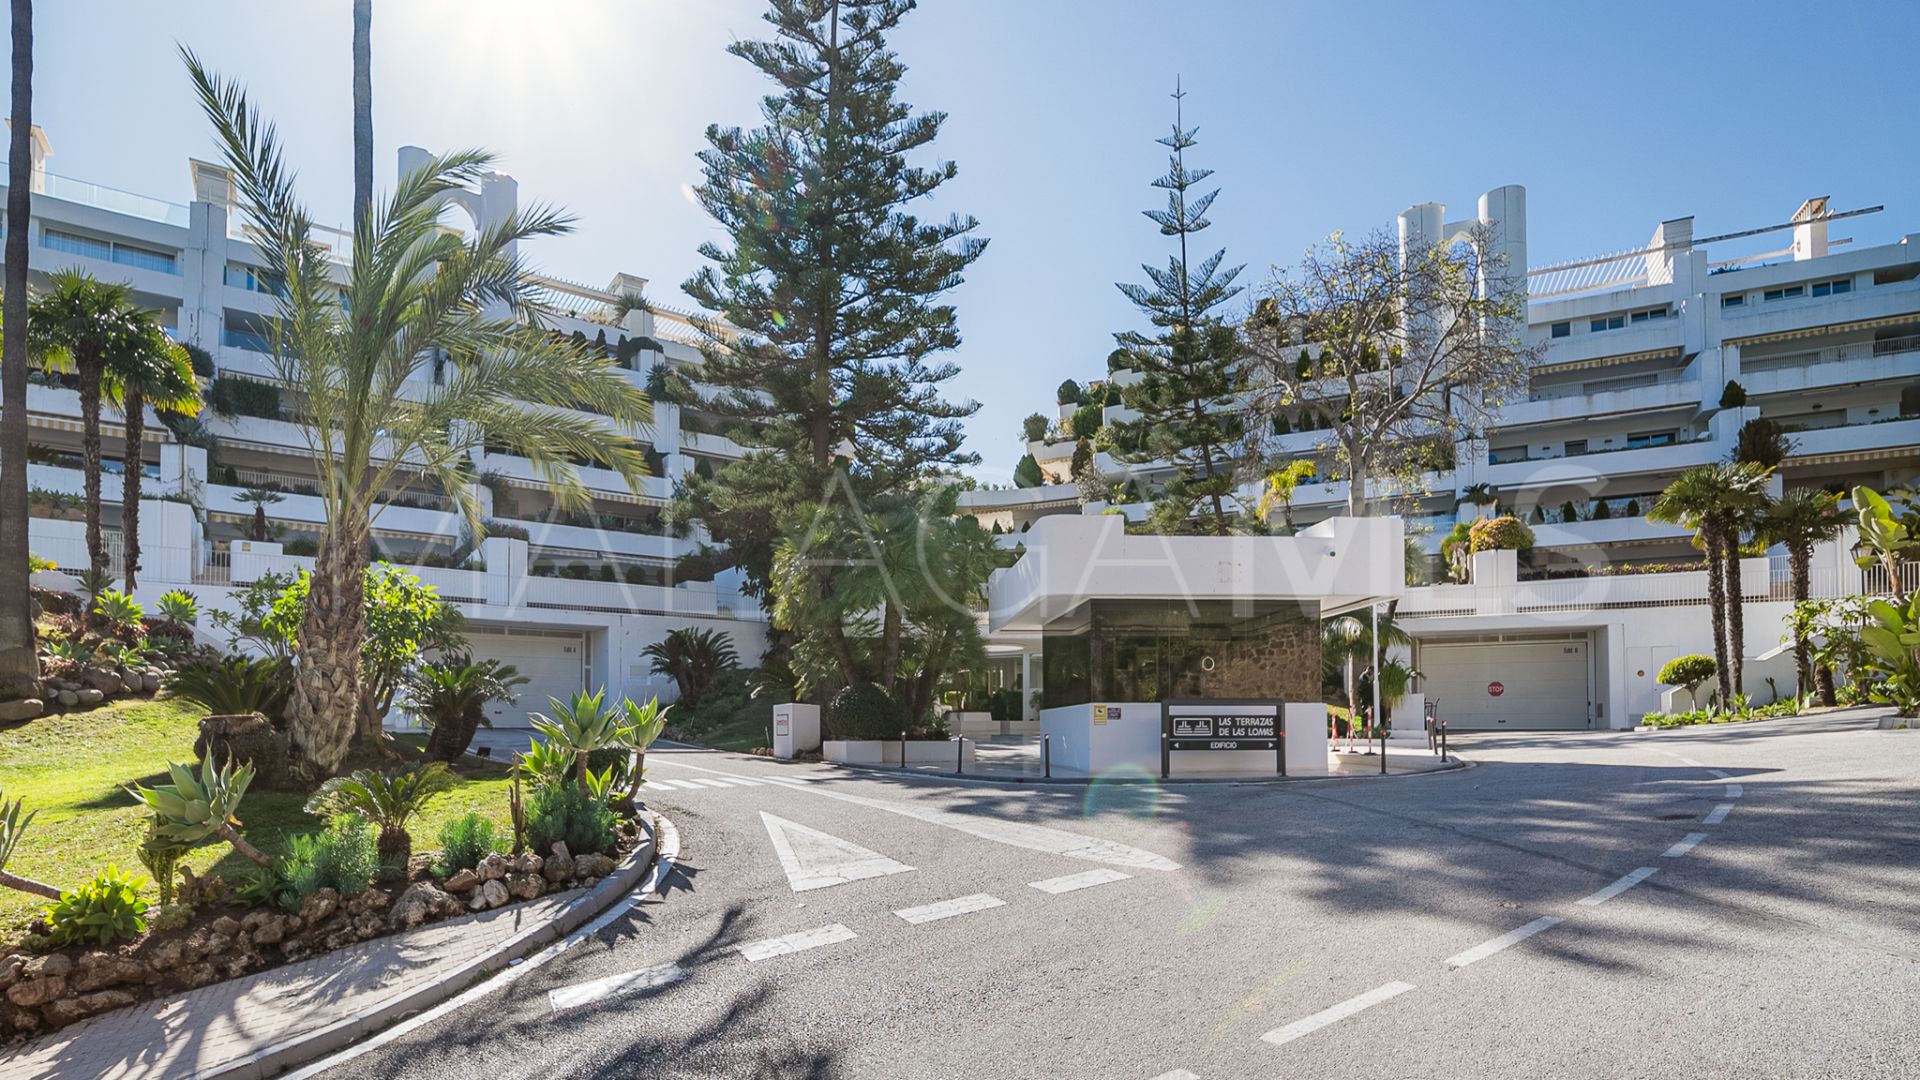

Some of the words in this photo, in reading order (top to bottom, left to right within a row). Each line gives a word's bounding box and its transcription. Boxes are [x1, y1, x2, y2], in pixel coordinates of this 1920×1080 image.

[1488, 685, 1504, 693] STOP
[1218, 717, 1232, 726] LAS
[1235, 717, 1274, 726] TERRAZAS
[1218, 727, 1230, 736] DE
[1232, 727, 1245, 736] LAS
[1248, 727, 1274, 736] LOMAS
[1210, 741, 1237, 749] EDIFICIO
